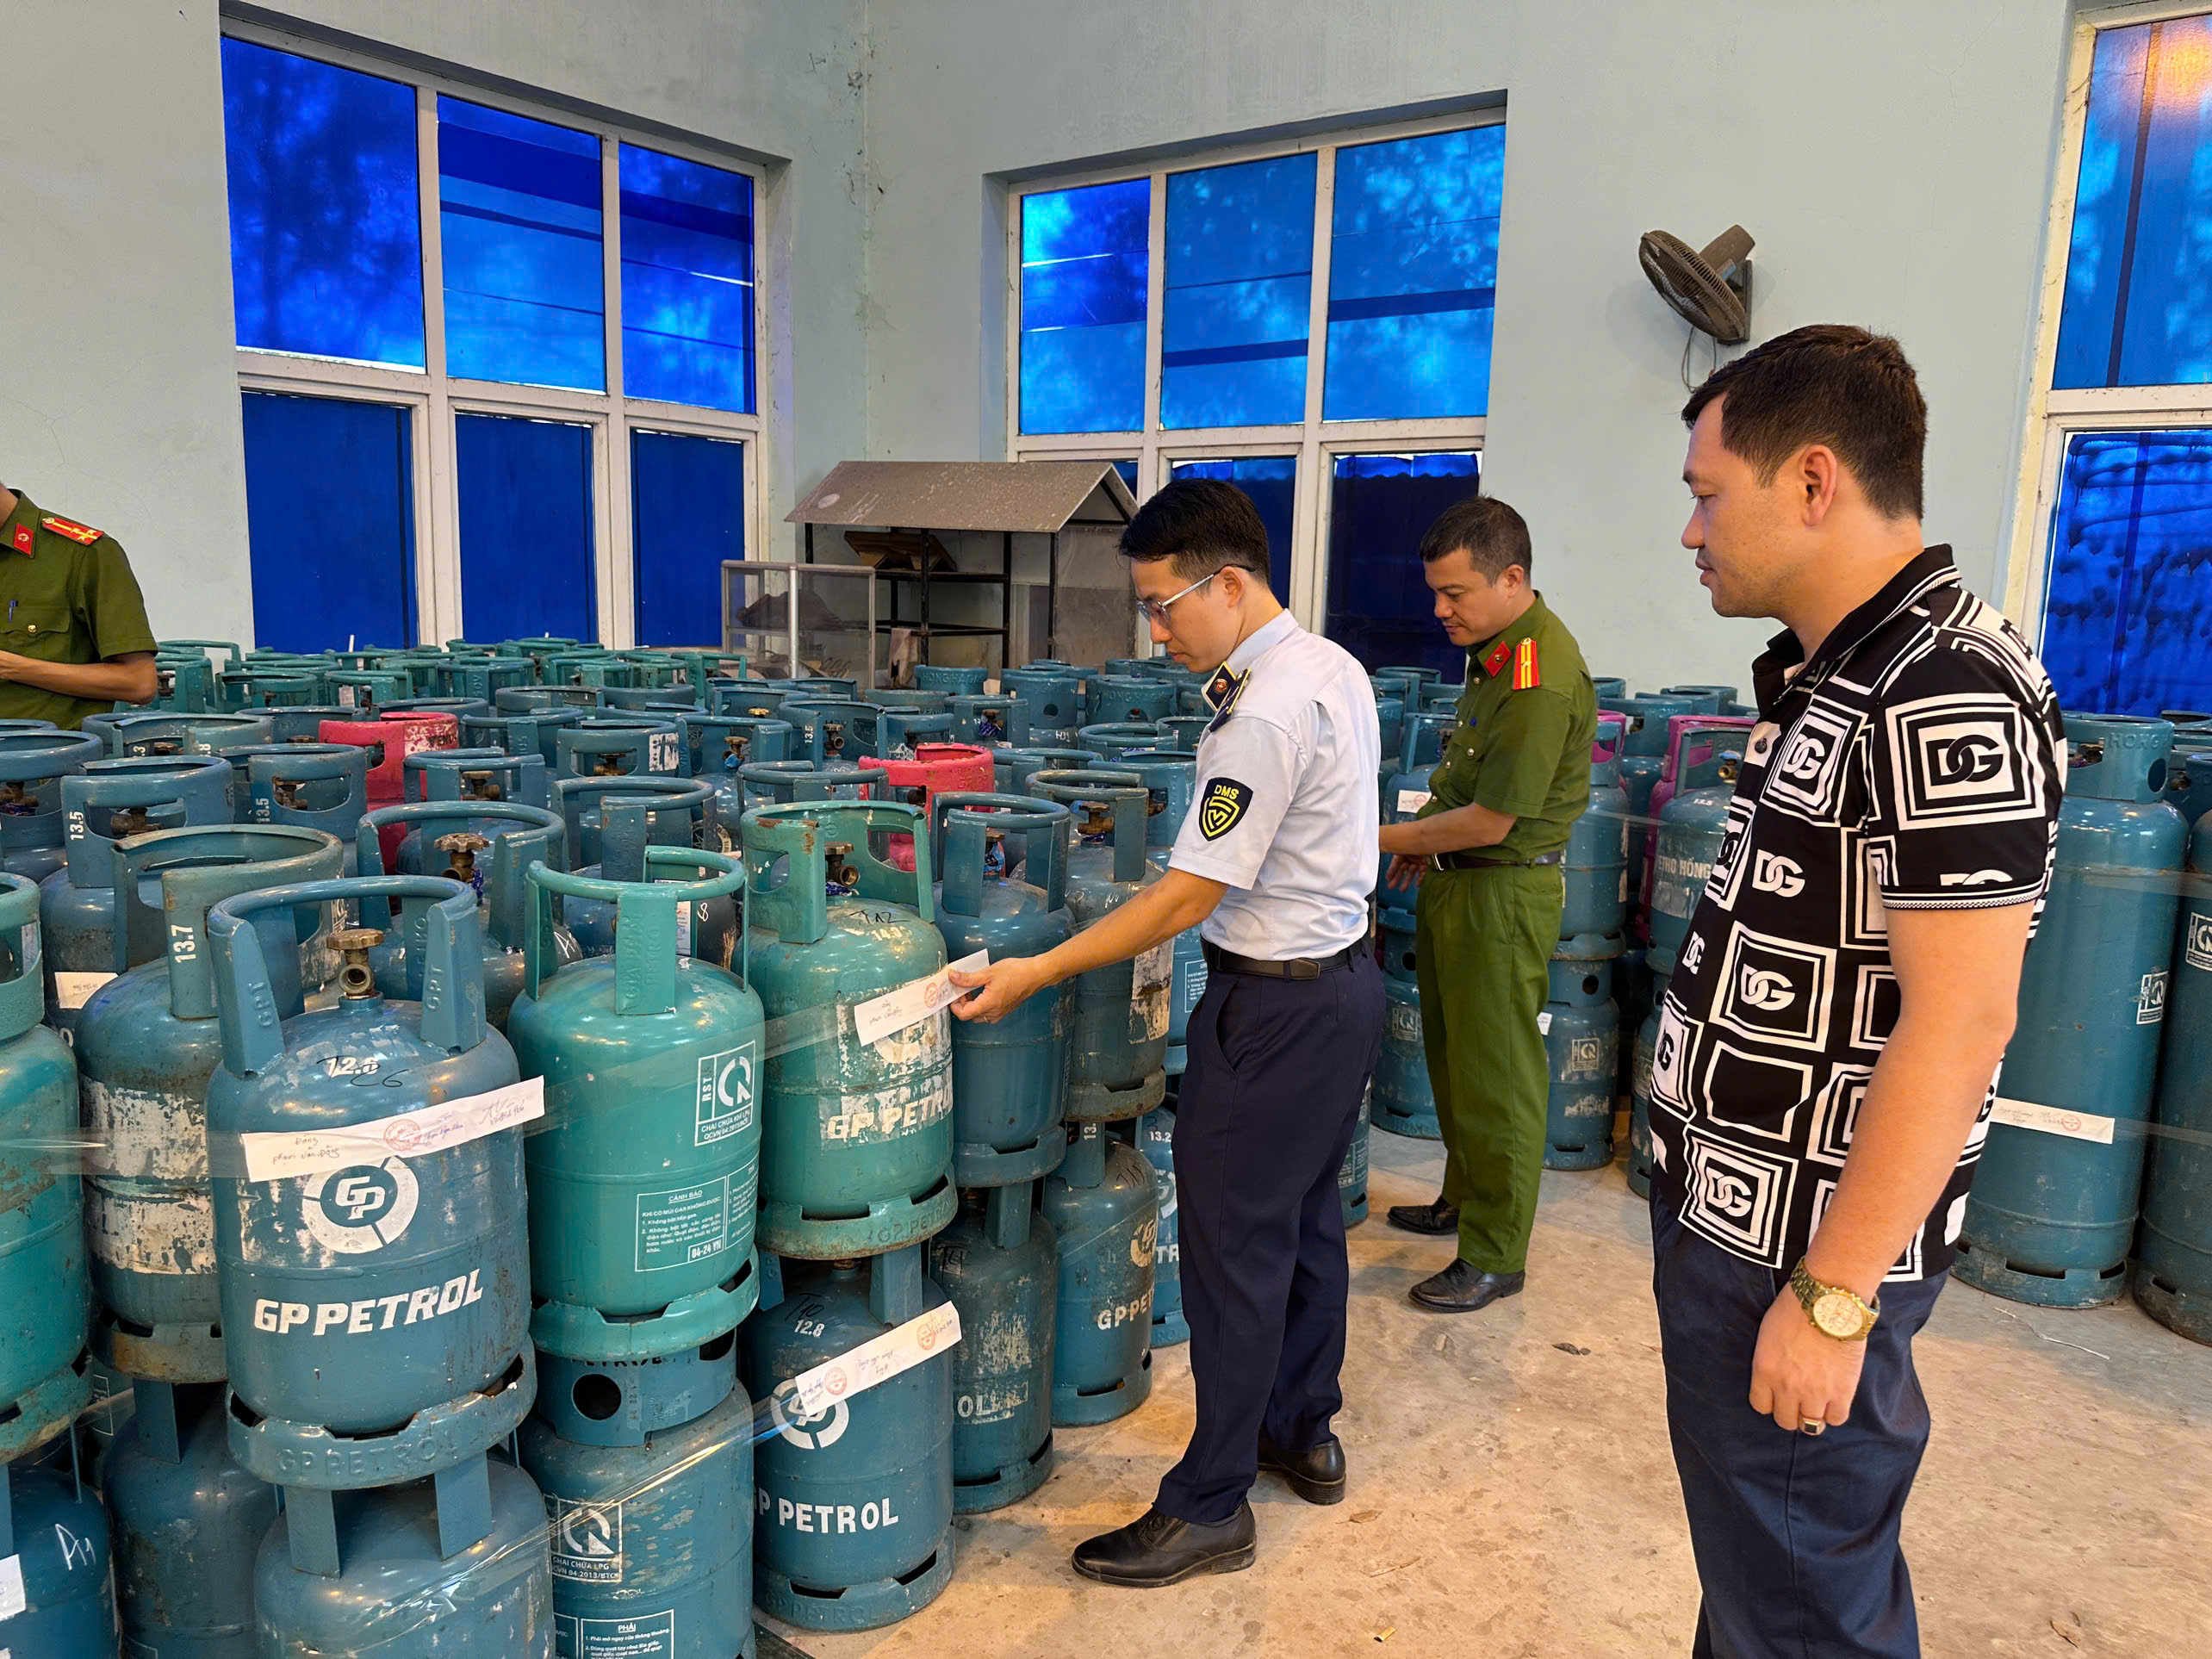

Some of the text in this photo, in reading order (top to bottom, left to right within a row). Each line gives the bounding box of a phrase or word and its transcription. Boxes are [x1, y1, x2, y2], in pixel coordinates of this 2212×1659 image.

[804, 724, 814, 743] 13.5
[1782, 733, 1825, 780] DG
[1925, 734, 2004, 786] DG
[1214, 785, 1240, 799] DMS
[256, 798, 270, 823] 13.5
[70, 811, 84, 841] 13.5
[1752, 849, 1805, 898] DG
[171, 924, 197, 963] 13.7
[1741, 963, 1795, 1010] DG
[701, 1122, 717, 1133] CHAI
[827, 1111, 874, 1140] GP
[1083, 1122, 1097, 1140] 13.
[335, 1176, 385, 1220] GP
[1706, 1166, 1752, 1218] DG
[692, 1244, 711, 1258] 04-24
[793, 1319, 825, 1338] 12.8
[778, 1497, 899, 1534] PETROL
[552, 1556, 569, 1567] CHAI
[570, 1560, 592, 1569] CHỨA
[552, 1565, 567, 1575] CVN
[618, 1622, 637, 1631] PHẢI
